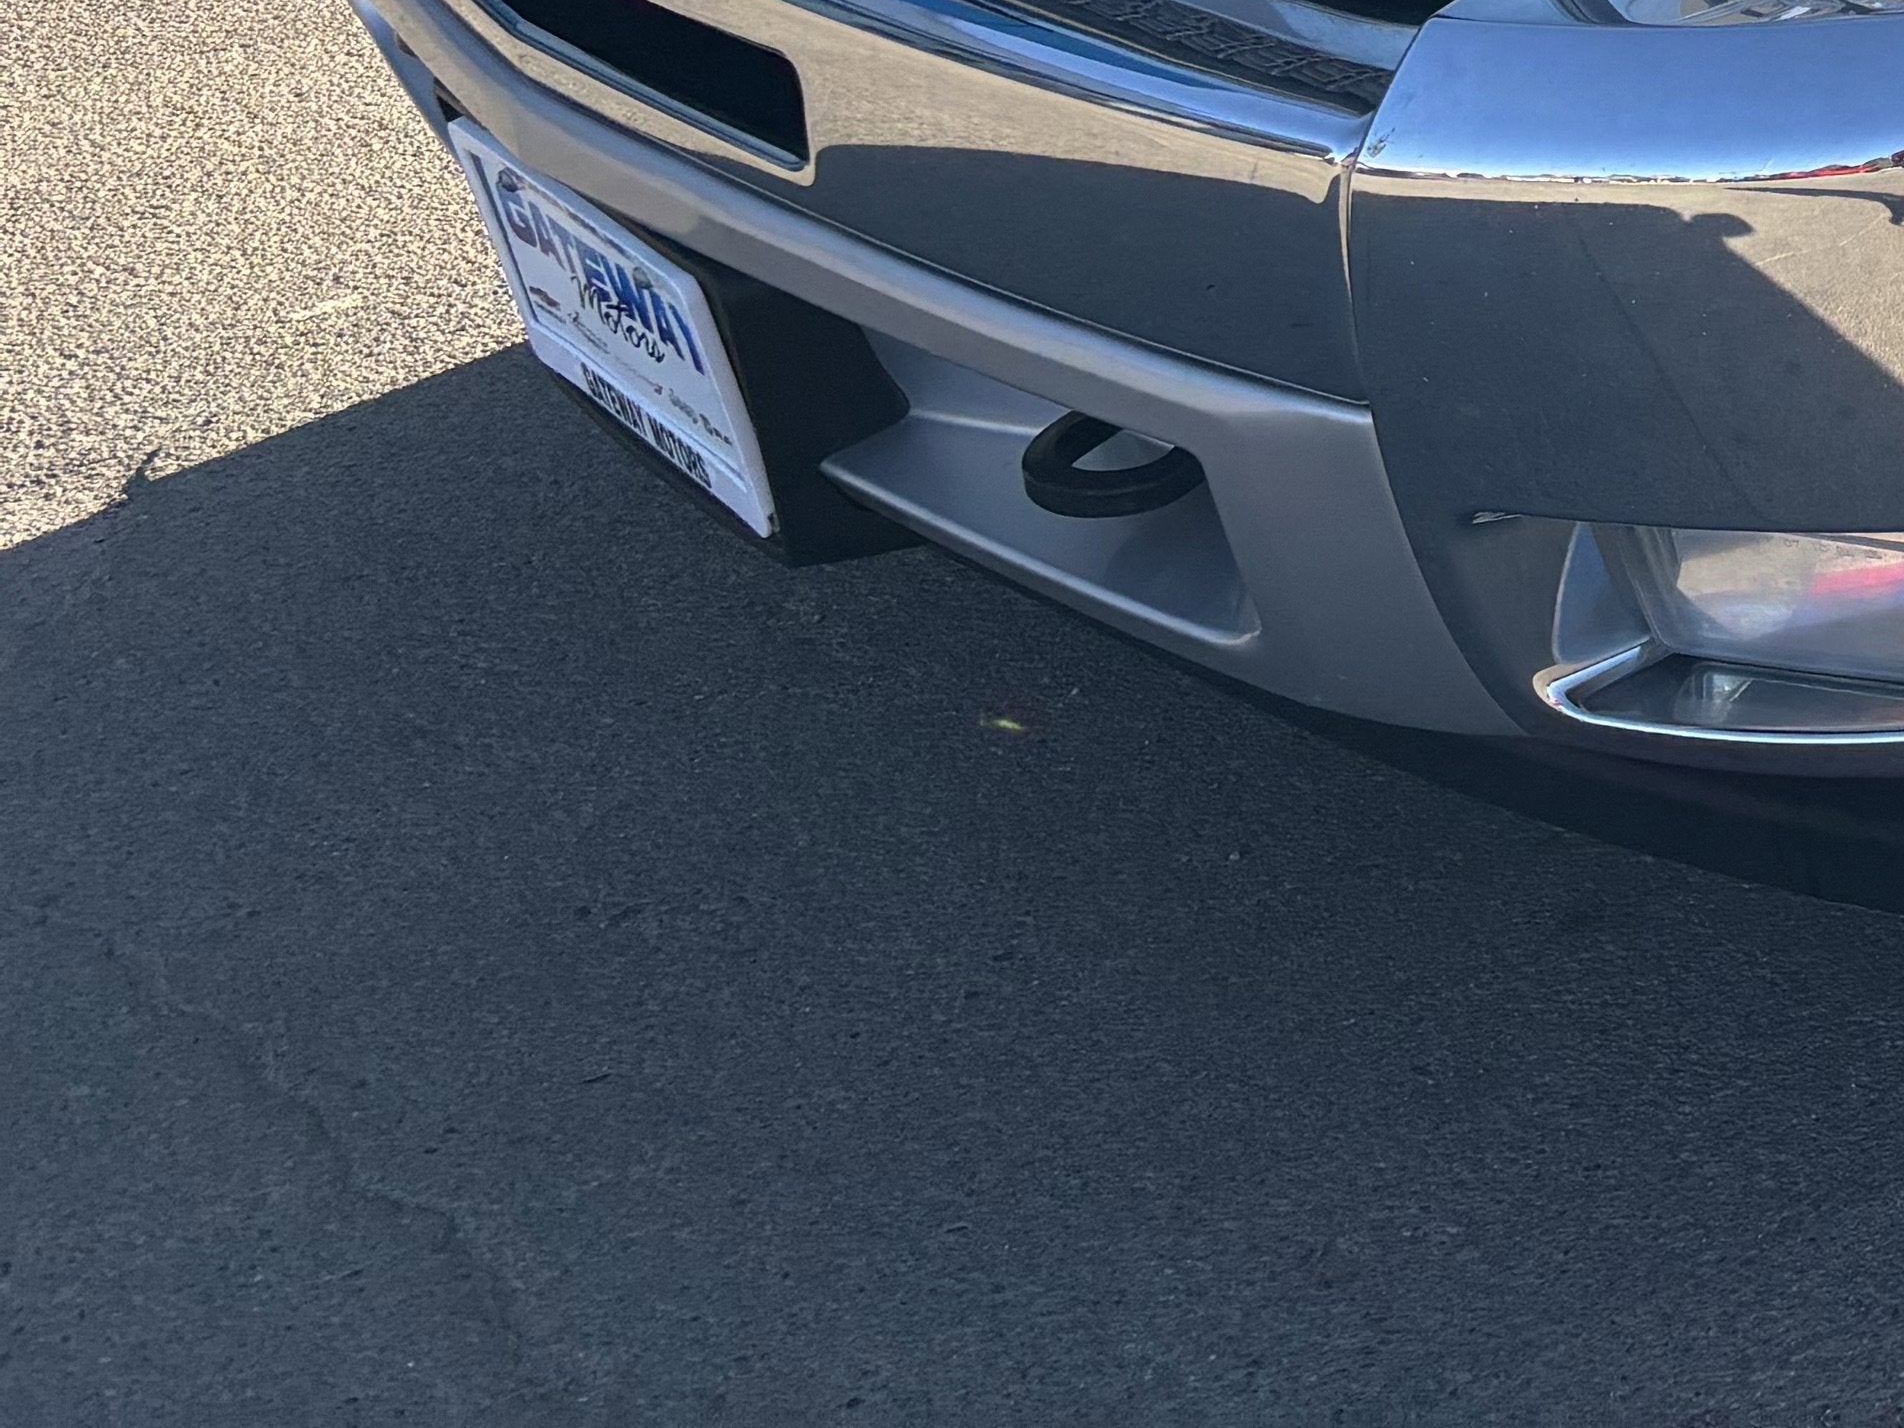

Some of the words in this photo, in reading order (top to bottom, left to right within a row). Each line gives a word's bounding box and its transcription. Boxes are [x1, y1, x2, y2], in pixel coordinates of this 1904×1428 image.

[498, 190, 705, 377] GATEWAY
[569, 272, 666, 363] Motors
[580, 361, 648, 438] GATEWAY
[646, 411, 712, 489] MOTORS
